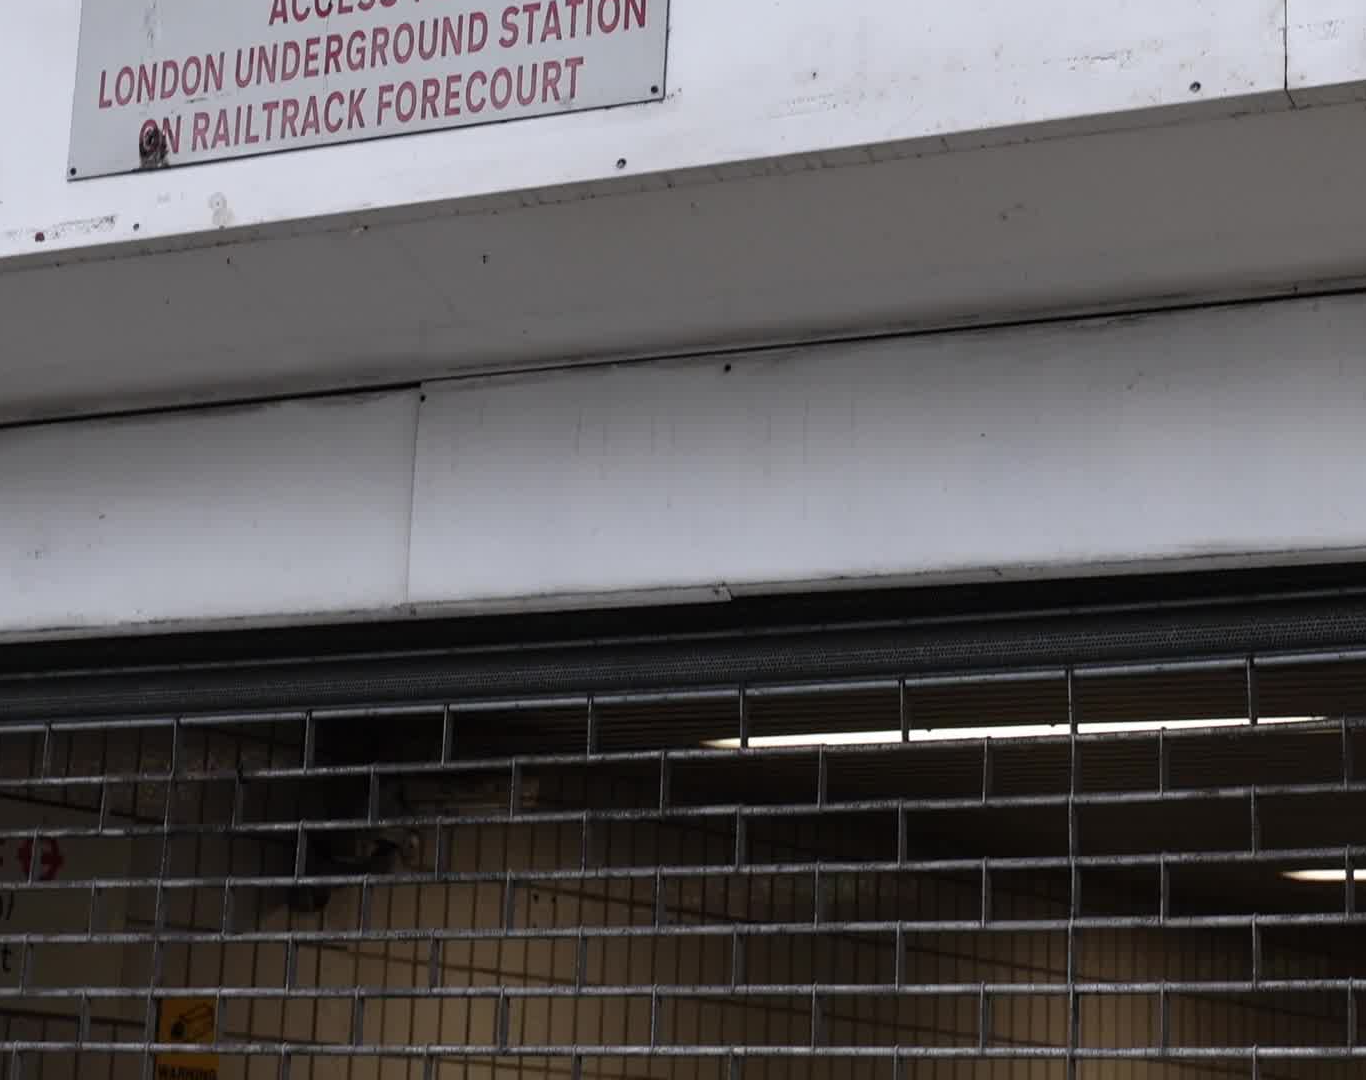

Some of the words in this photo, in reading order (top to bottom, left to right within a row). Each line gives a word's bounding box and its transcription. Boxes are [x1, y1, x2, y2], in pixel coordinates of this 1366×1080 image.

[98, 51, 225, 110] LONDON
[235, 7, 489, 88] UNDERGROUND
[139, 114, 181, 157] ON
[191, 85, 368, 151] RAILTRACK
[377, 55, 585, 122] FORECOURT
